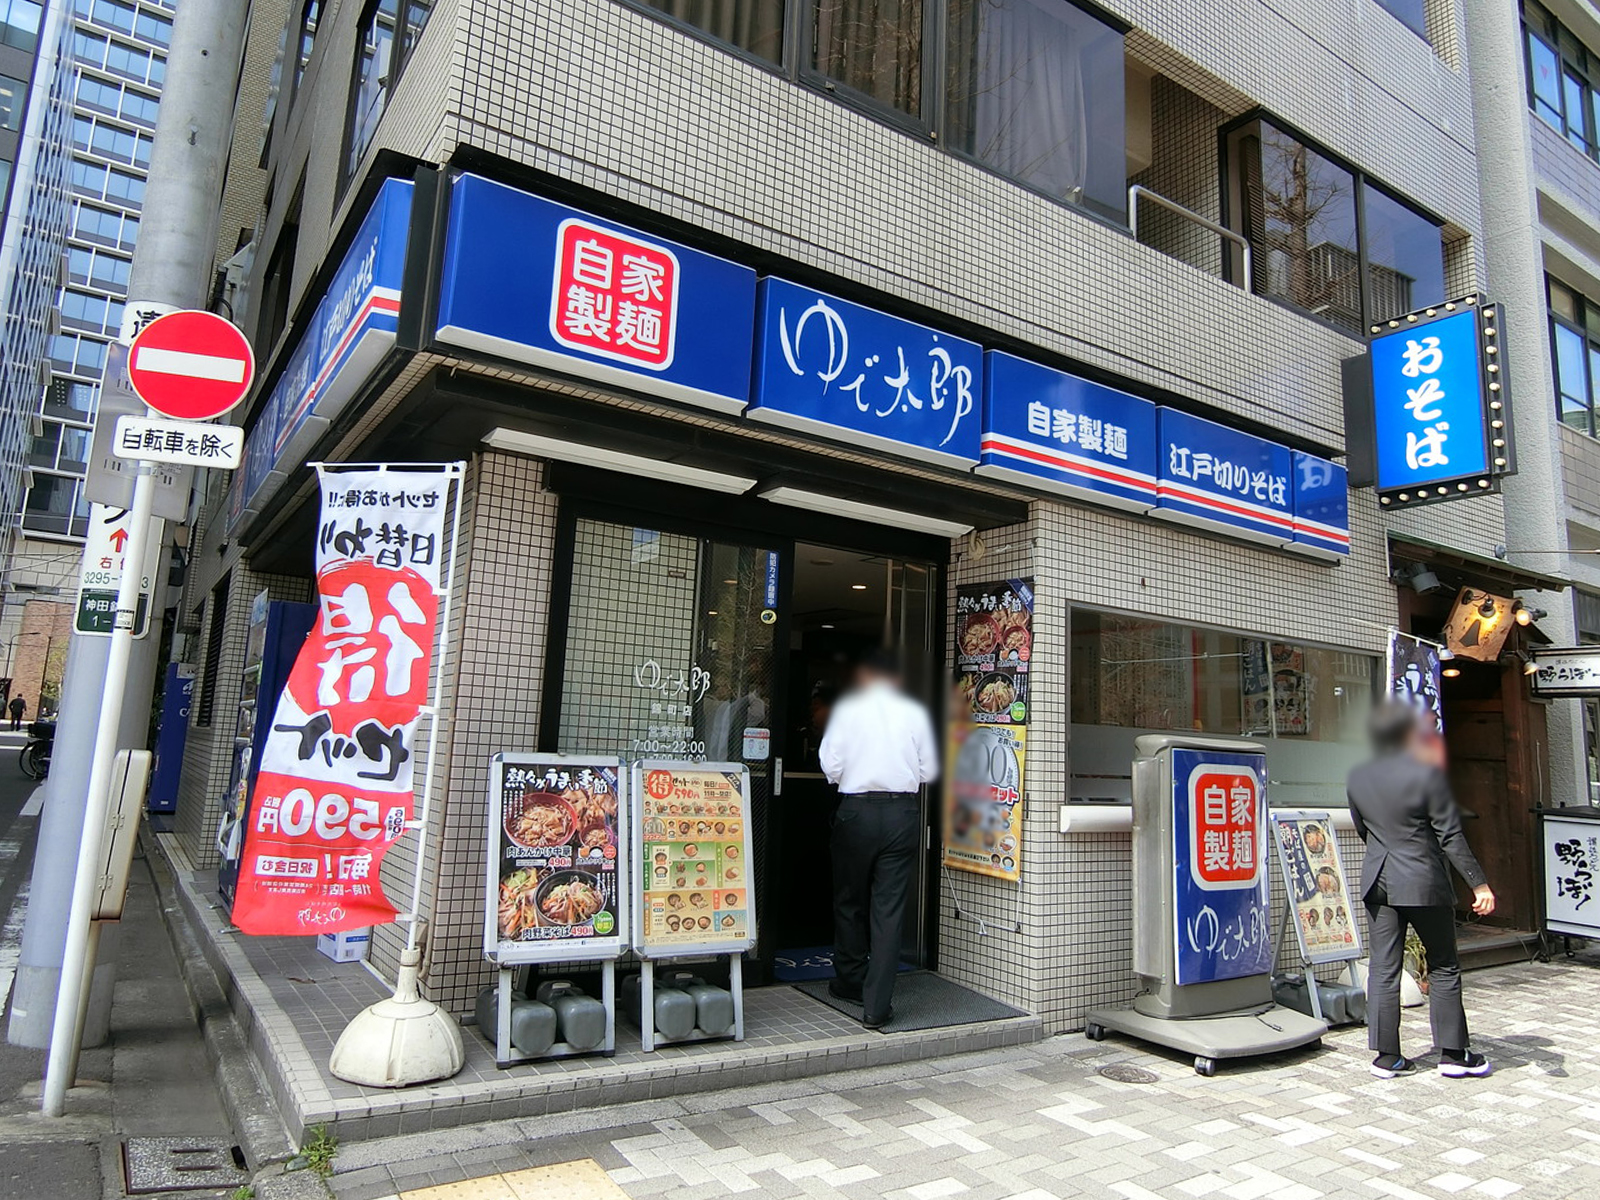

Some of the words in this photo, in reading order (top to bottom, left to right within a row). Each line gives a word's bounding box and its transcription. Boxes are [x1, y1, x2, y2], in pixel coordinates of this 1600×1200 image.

[573, 238, 665, 302] 自家
[563, 284, 663, 355] 製麺
[779, 298, 973, 447] ゆで太郎
[1026, 400, 1128, 460] 自家製麺
[1401, 336, 1450, 470] おそば
[122, 427, 234, 459] 自転車を除く
[1169, 442, 1287, 507] 江戸切りそば
[635, 659, 711, 703] ゆで太郎
[648, 725, 694, 739] 営業時間
[651, 773, 670, 795] 得
[1204, 784, 1252, 826] 自家
[1203, 829, 1254, 872] 製麺
[1186, 900, 1270, 964] ゆで太郎
